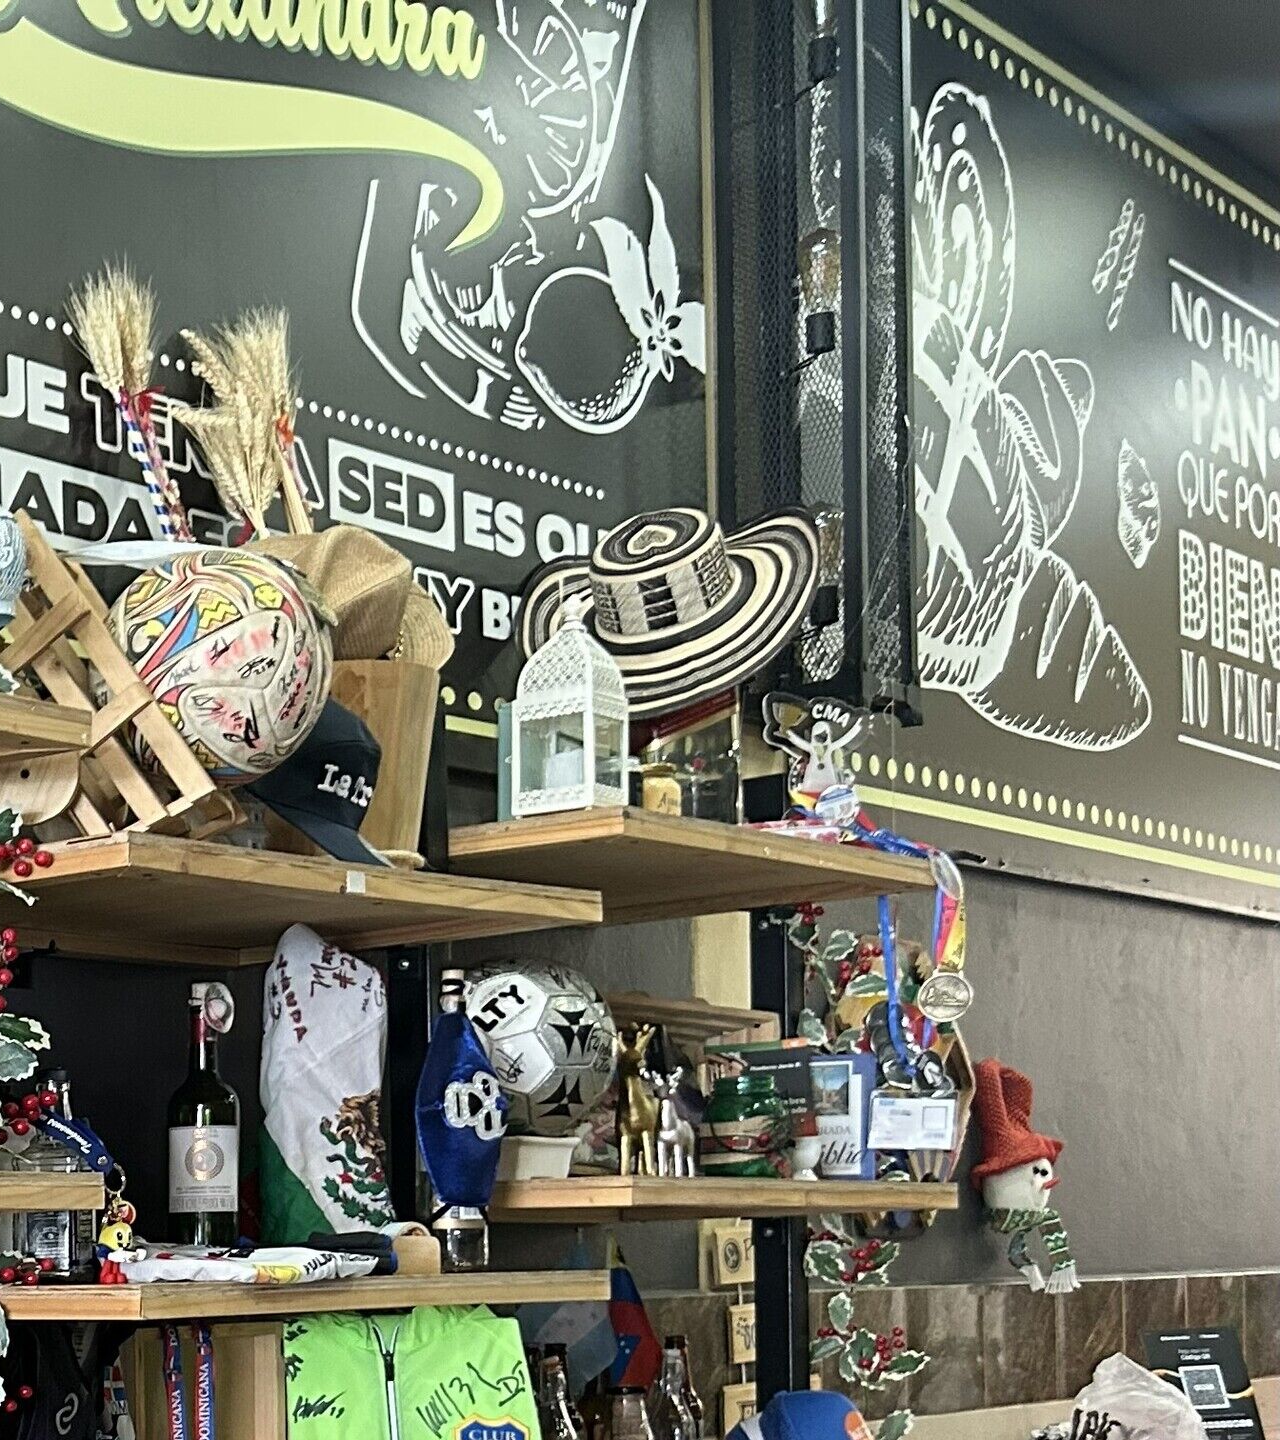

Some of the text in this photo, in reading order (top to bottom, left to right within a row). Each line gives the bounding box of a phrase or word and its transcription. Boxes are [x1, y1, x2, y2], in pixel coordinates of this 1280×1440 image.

[1171, 280, 1280, 402] NO HAY
[337, 455, 446, 534] SED
[463, 490, 526, 558] ES
[1177, 449, 1230, 520] QUE
[811, 703, 852, 727] CMA
[1180, 648, 1280, 751] NO VENG
